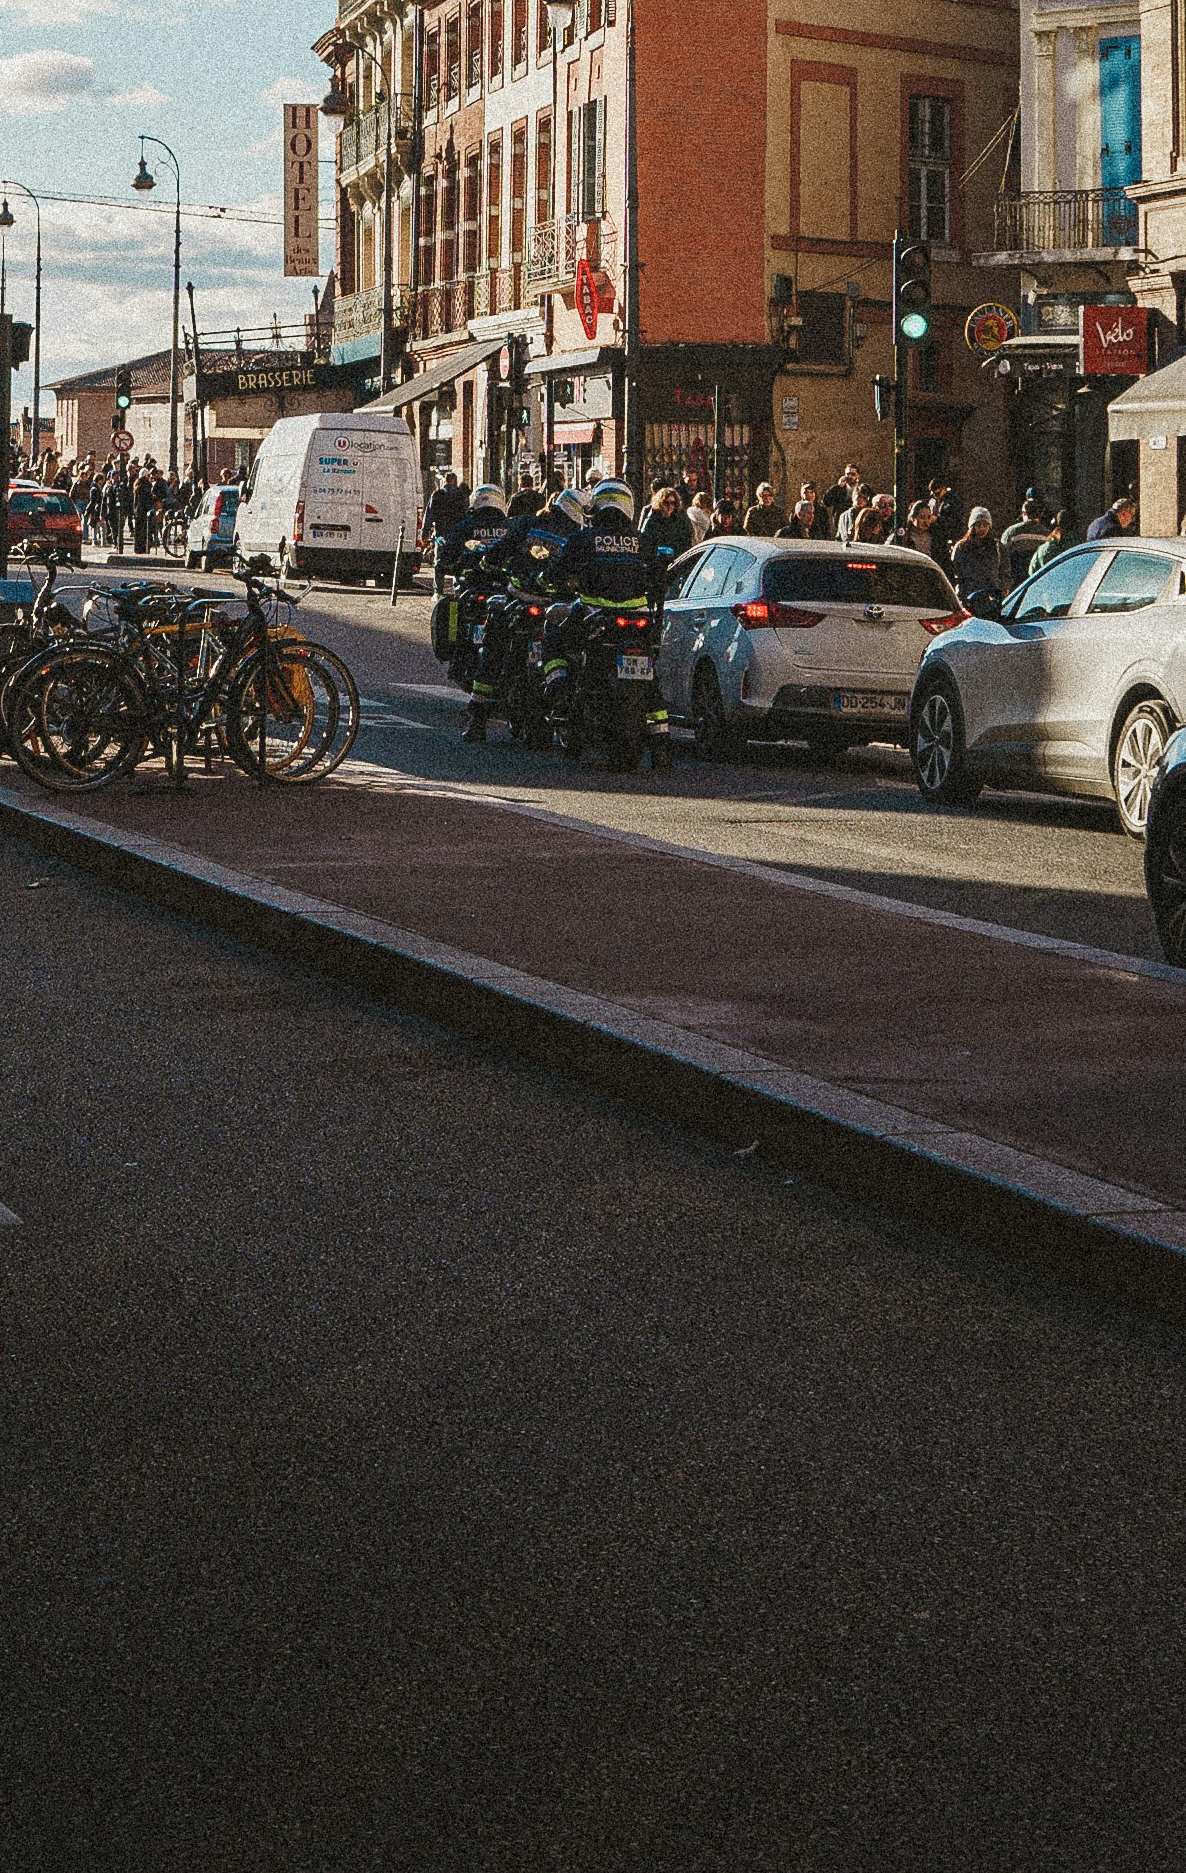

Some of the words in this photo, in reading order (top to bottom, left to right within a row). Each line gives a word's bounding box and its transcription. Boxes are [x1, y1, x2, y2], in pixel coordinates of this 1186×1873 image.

[289, 106, 312, 238] HOTEL
[581, 275, 594, 324] TABAC
[1095, 317, 1135, 348] Vélo
[238, 369, 316, 390] BRASSERIE
[318, 457, 349, 466] SUPER
[595, 535, 640, 546] POLICE
